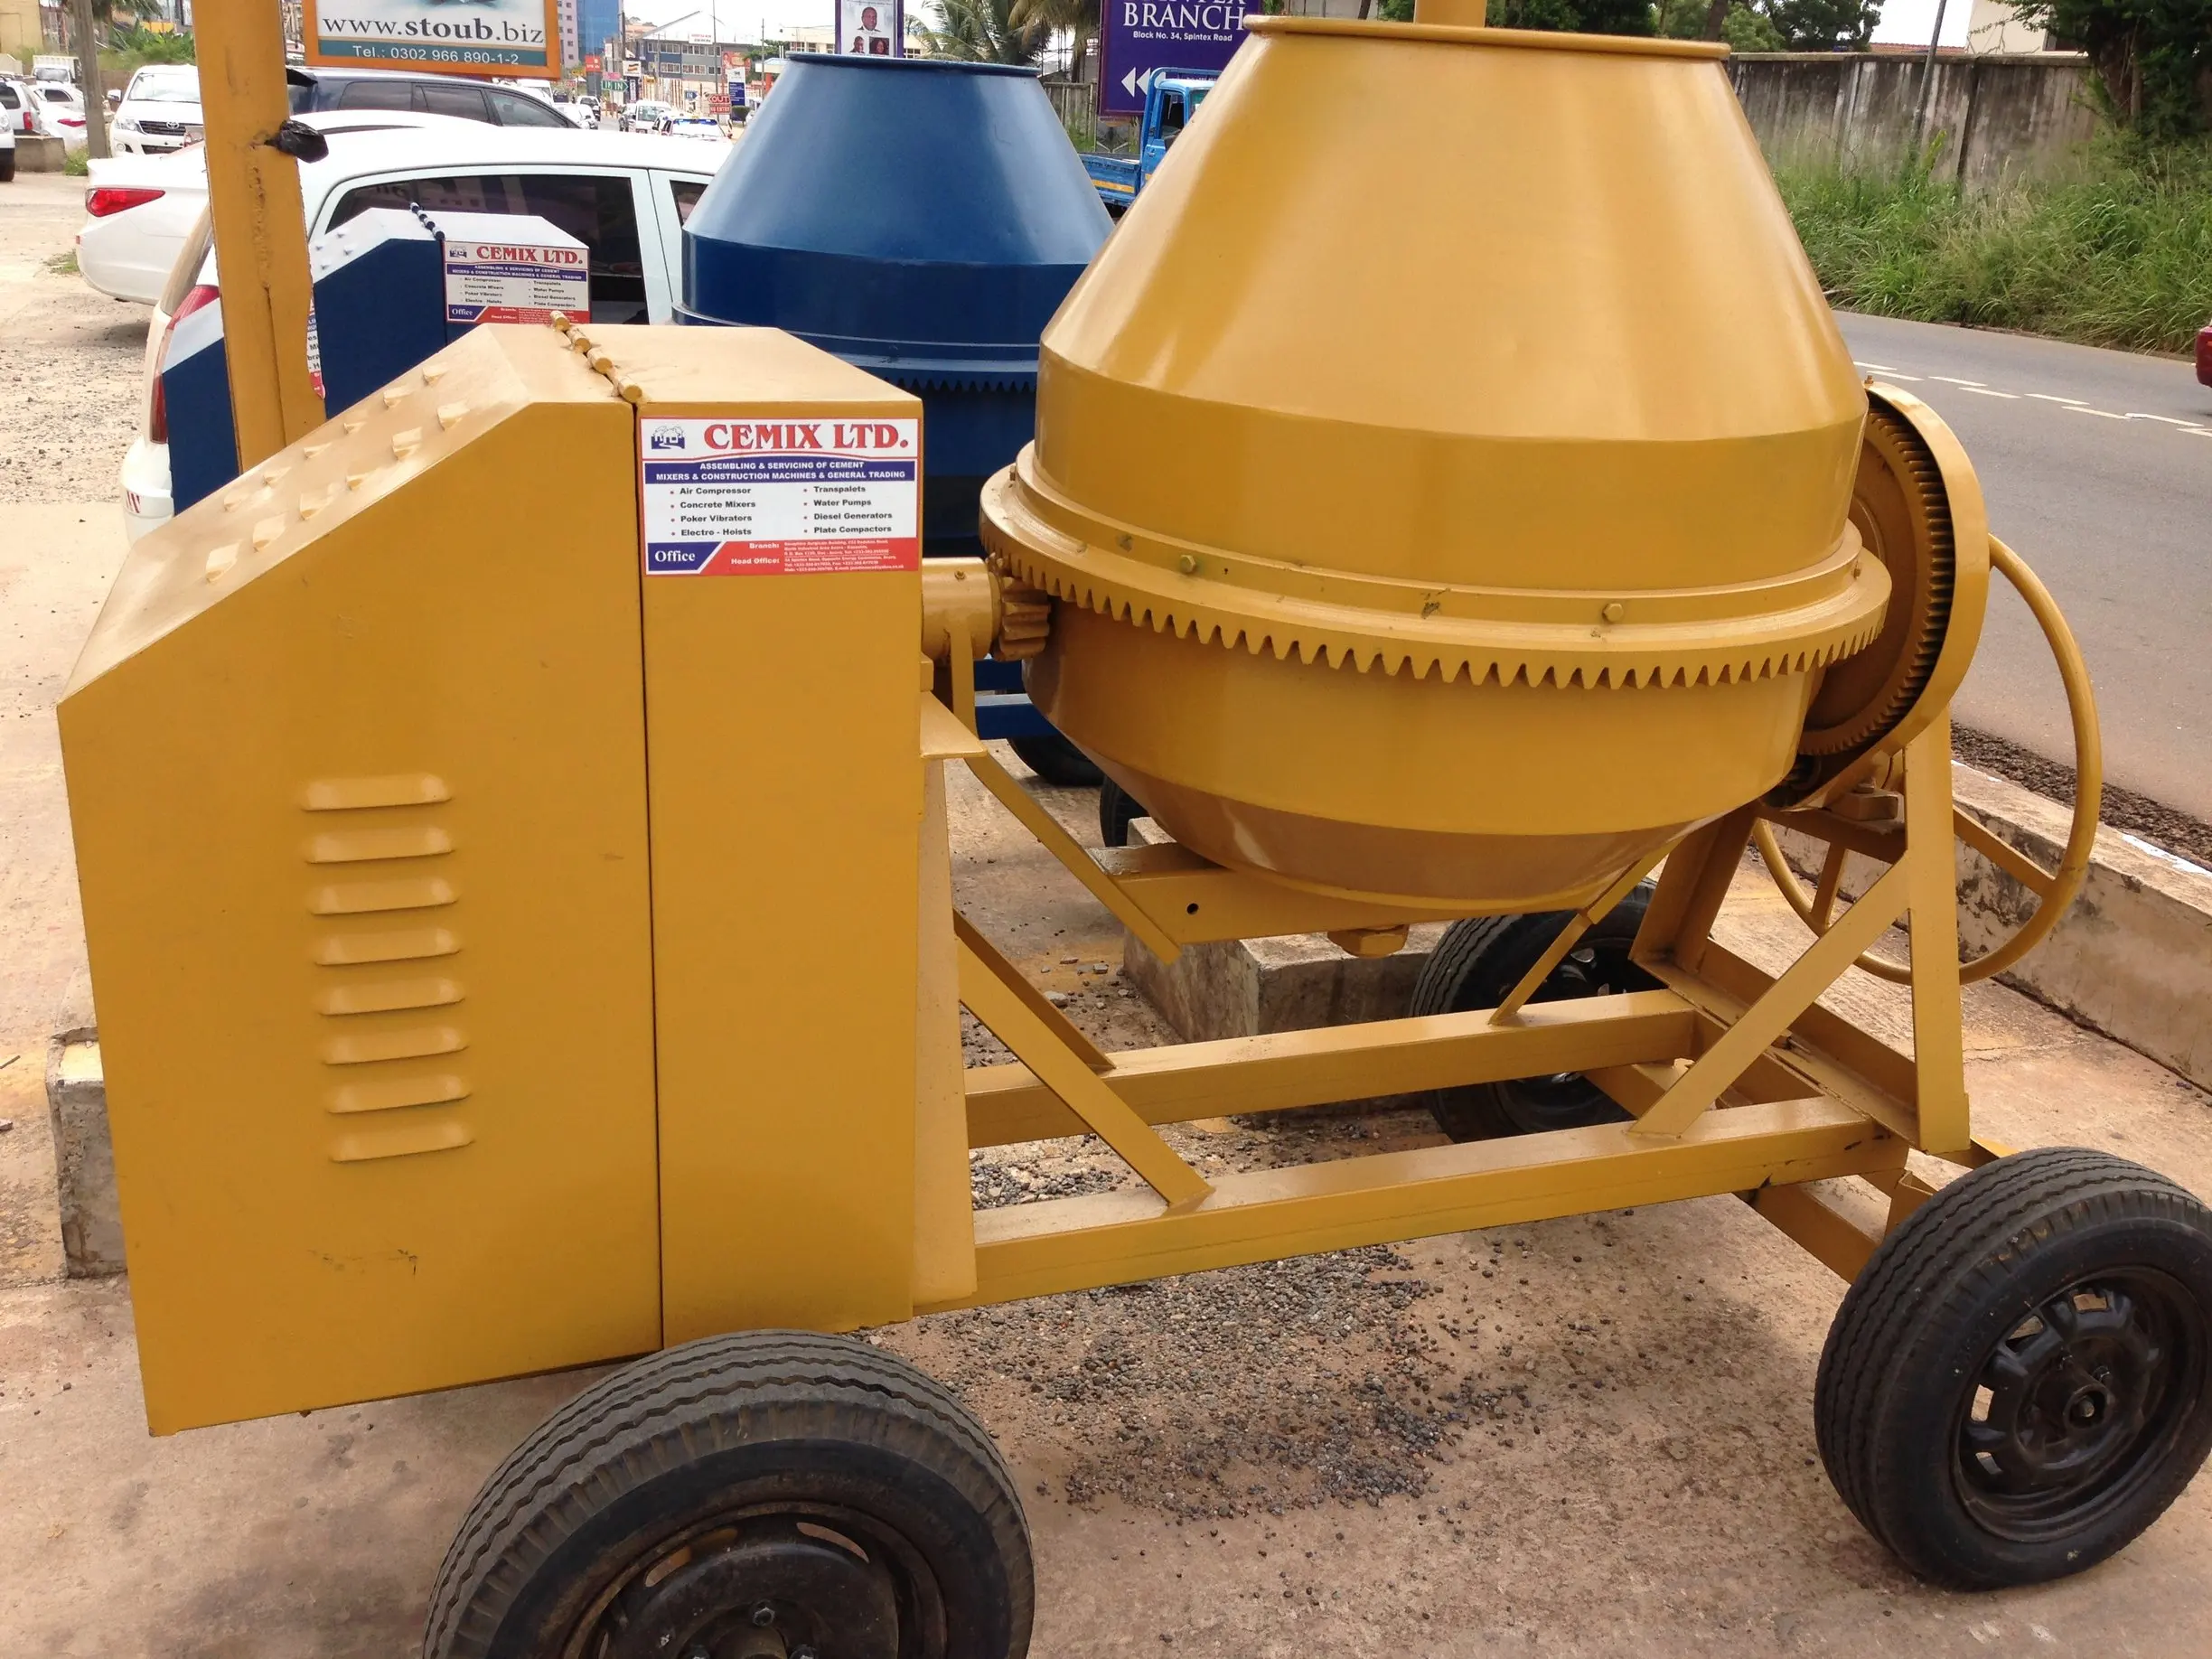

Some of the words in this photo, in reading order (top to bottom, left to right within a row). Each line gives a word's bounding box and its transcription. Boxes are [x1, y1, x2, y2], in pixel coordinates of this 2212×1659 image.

[1123, 3, 1245, 31] BRANCH
[323, 18, 544, 43] www.stoub.biz
[1133, 31, 1154, 39] Block
[1156, 32, 1168, 40] No.
[1170, 33, 1182, 41] 34,
[1184, 33, 1211, 42] Spintex
[1214, 33, 1233, 42] Road
[390, 47, 426, 61] 0302
[432, 49, 458, 62] 966
[464, 52, 519, 65] 890-1-2
[711, 95, 730, 103] OUT
[476, 246, 538, 262] CEMIX
[543, 249, 583, 265] LTD.
[452, 308, 473, 316] Office
[704, 424, 822, 450] CEMIX
[833, 424, 909, 449] LTD.
[828, 471, 867, 479] GENERAL
[696, 488, 752, 496] Compressor
[842, 499, 872, 507] Pumps
[709, 514, 753, 522] Vibrators
[839, 525, 892, 534] Compactors
[654, 549, 696, 563] Office
